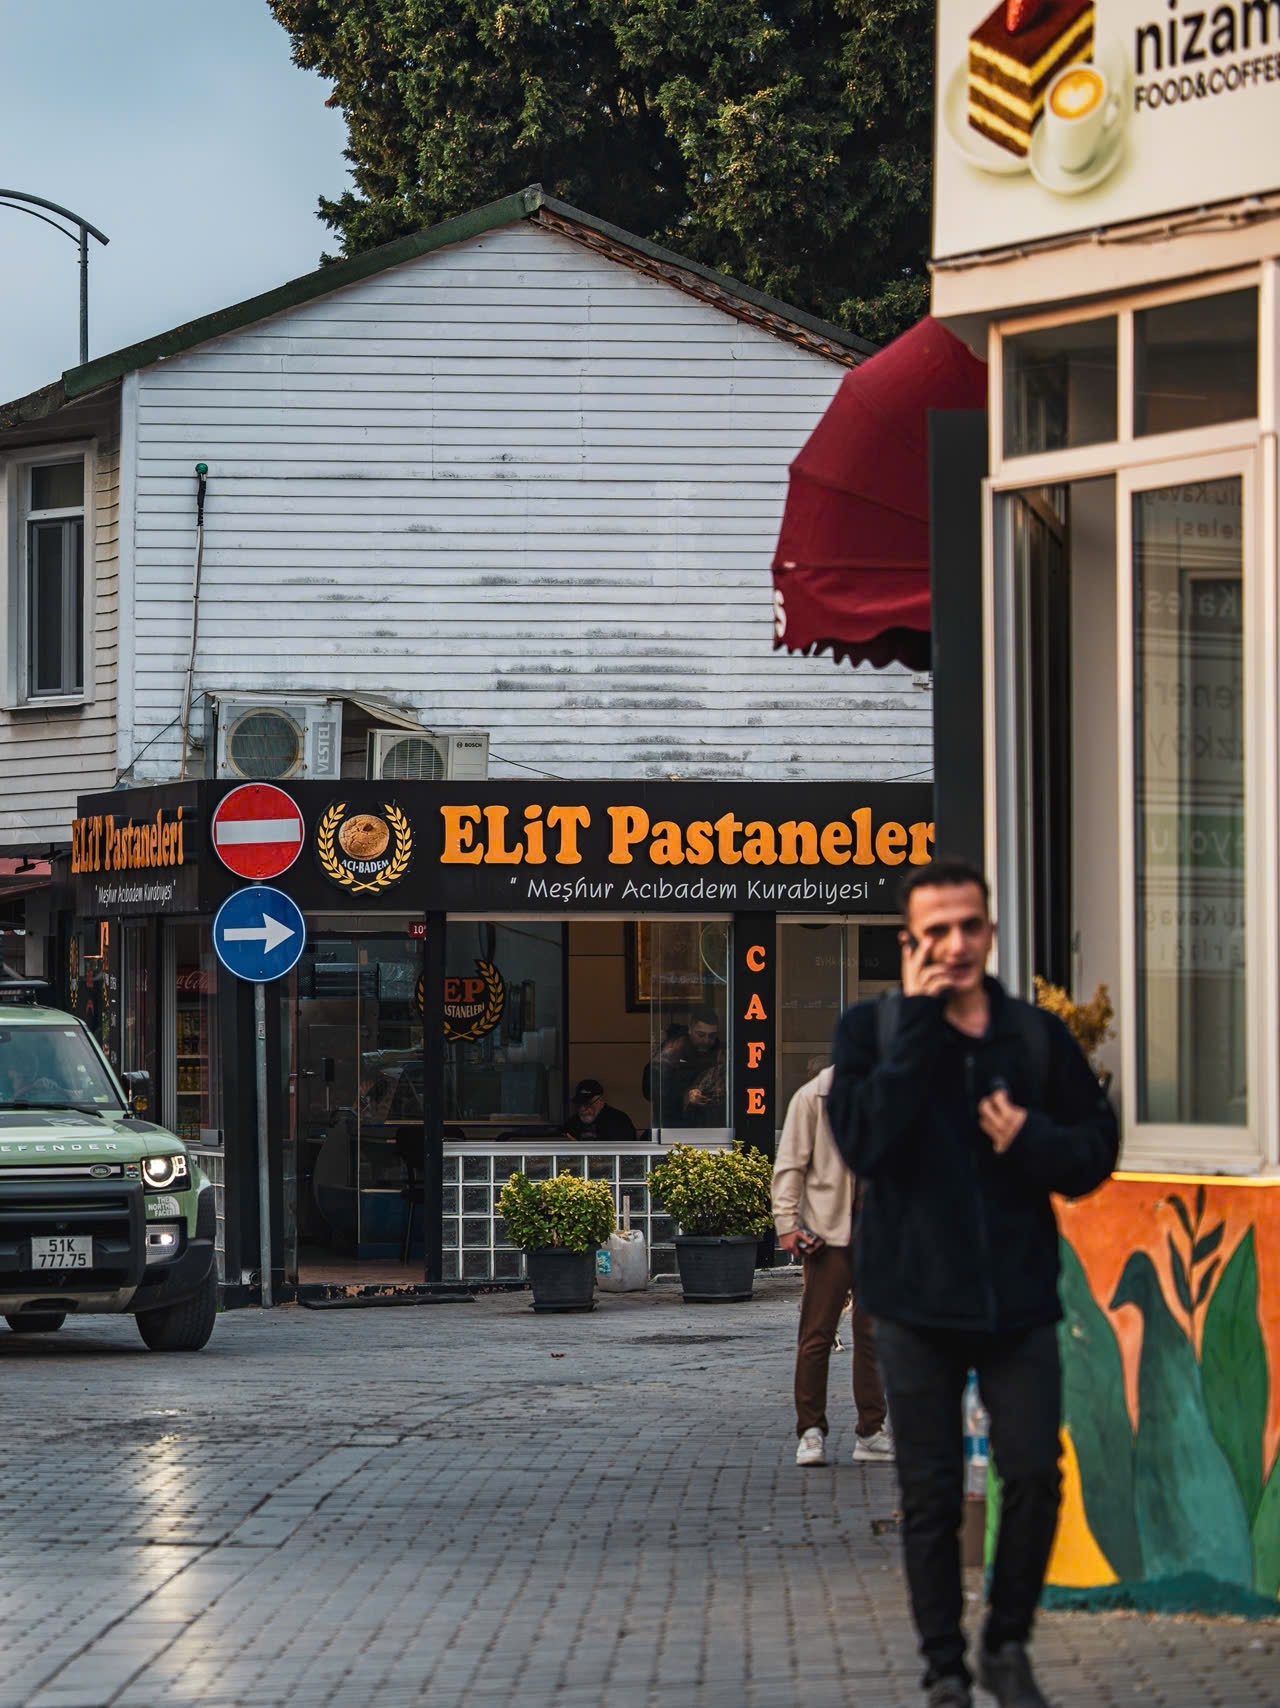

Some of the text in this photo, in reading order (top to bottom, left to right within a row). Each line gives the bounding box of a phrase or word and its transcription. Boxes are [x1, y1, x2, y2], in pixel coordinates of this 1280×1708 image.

[317, 722, 330, 773] VESTEL
[105, 806, 184, 871] Pastaneleri
[527, 877, 869, 905] Meşhur Acıbadem Kurabiyesi
[49, 1239, 74, 1252] 51K
[38, 1253, 87, 1268] 777.75
